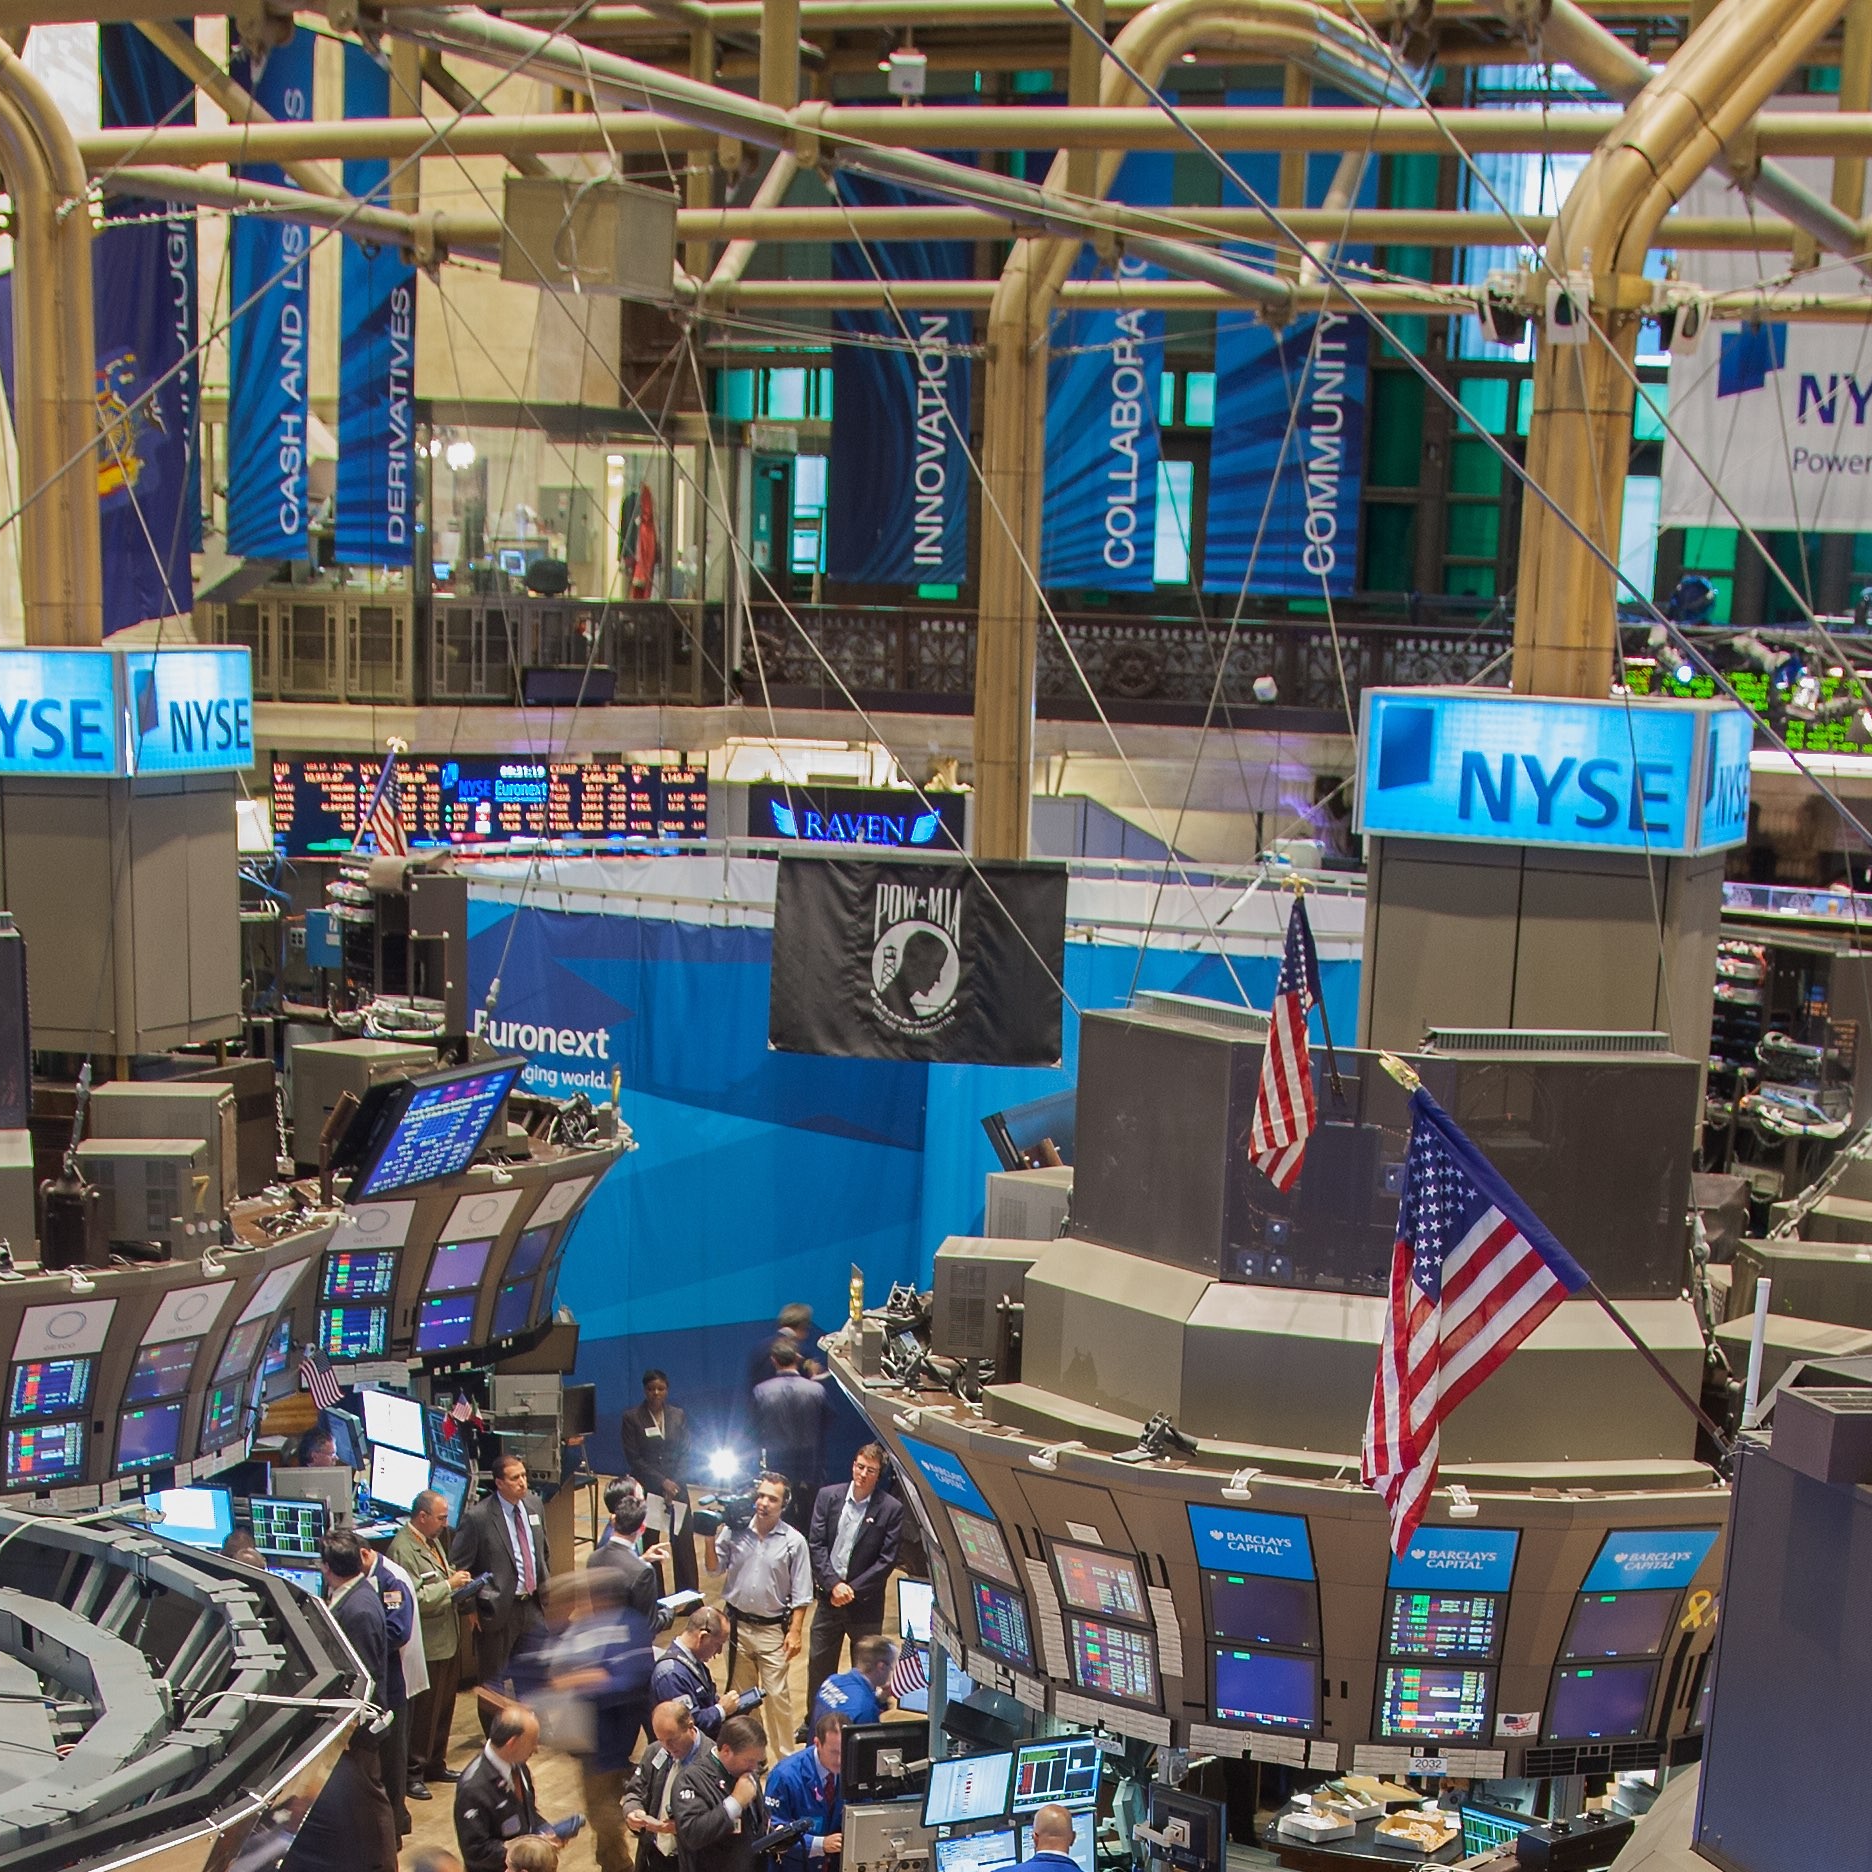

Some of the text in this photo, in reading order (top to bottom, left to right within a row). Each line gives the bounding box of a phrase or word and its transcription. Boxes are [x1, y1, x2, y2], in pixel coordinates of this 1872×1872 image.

[280, 305, 304, 535] CASH AND
[386, 287, 412, 545] DERIVATIVES
[914, 315, 951, 566] INNOVATION
[1302, 310, 1350, 576] COMMUNITY
[169, 698, 252, 753] NYSE
[458, 780, 549, 797] NYSE Euronext
[1458, 749, 1674, 835] NYSE
[804, 810, 906, 842] RAVEN
[874, 883, 962, 949] POW MIA
[474, 1011, 610, 1060] Euronext
[191, 1174, 210, 1213] 7
[1227, 1532, 1292, 1548] BARCLAYS
[1227, 1541, 1284, 1556] CAPITAL
[1428, 1550, 1498, 1562] BARCLAYS
[1426, 1558, 1483, 1570] CAPITAL
[1624, 1559, 1677, 1571] CAPITAL
[1627, 1551, 1692, 1566] BARCLAYS
[1415, 1758, 1442, 1769] 2032
